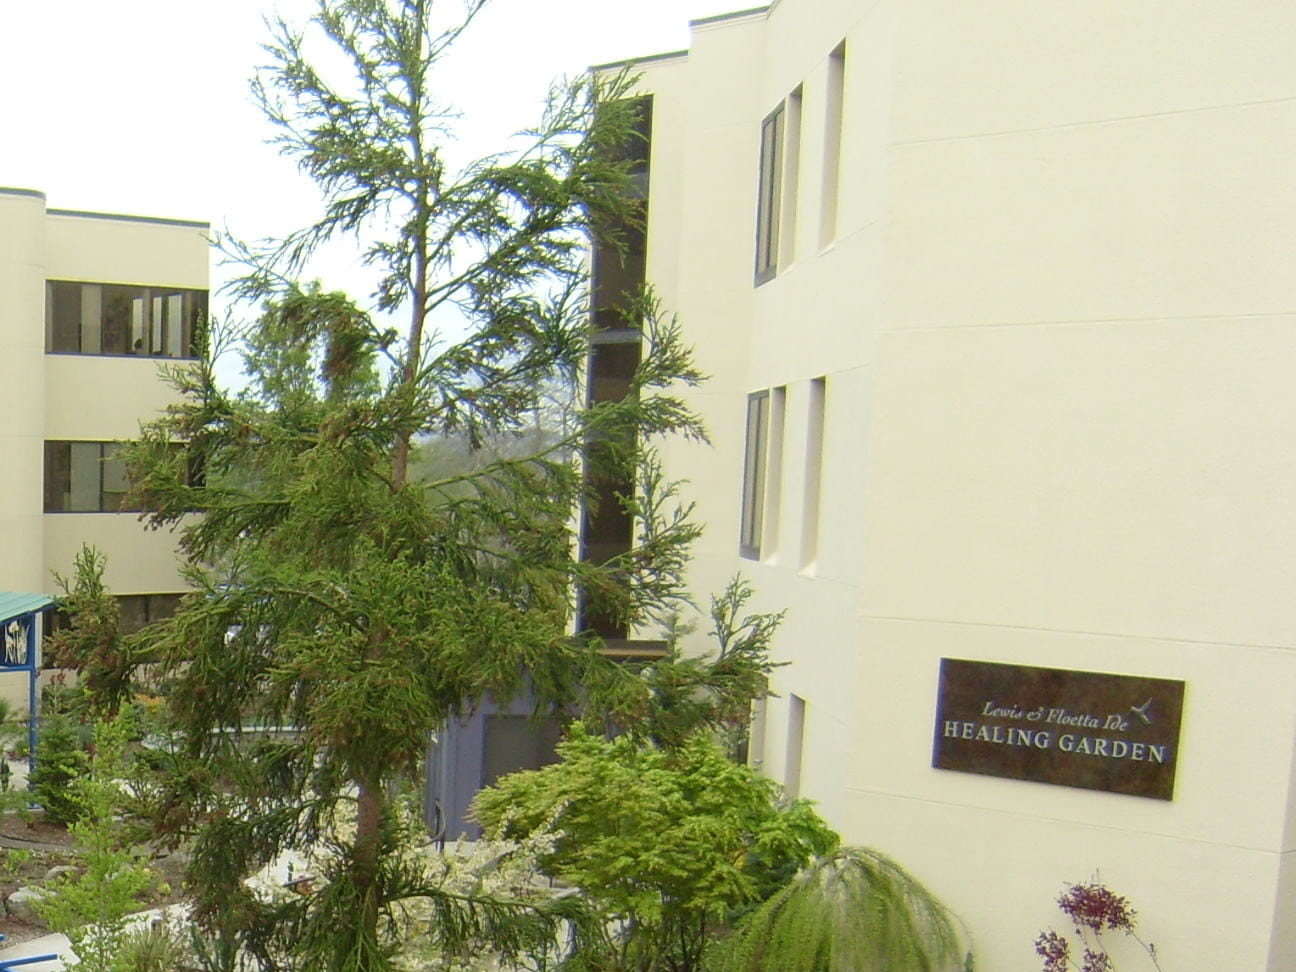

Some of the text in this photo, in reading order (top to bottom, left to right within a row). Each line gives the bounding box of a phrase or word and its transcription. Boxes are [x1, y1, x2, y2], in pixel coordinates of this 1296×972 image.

[982, 701, 1129, 732] Lewis & Floetta Ide
[943, 720, 1166, 764] HEALING GARDEN
